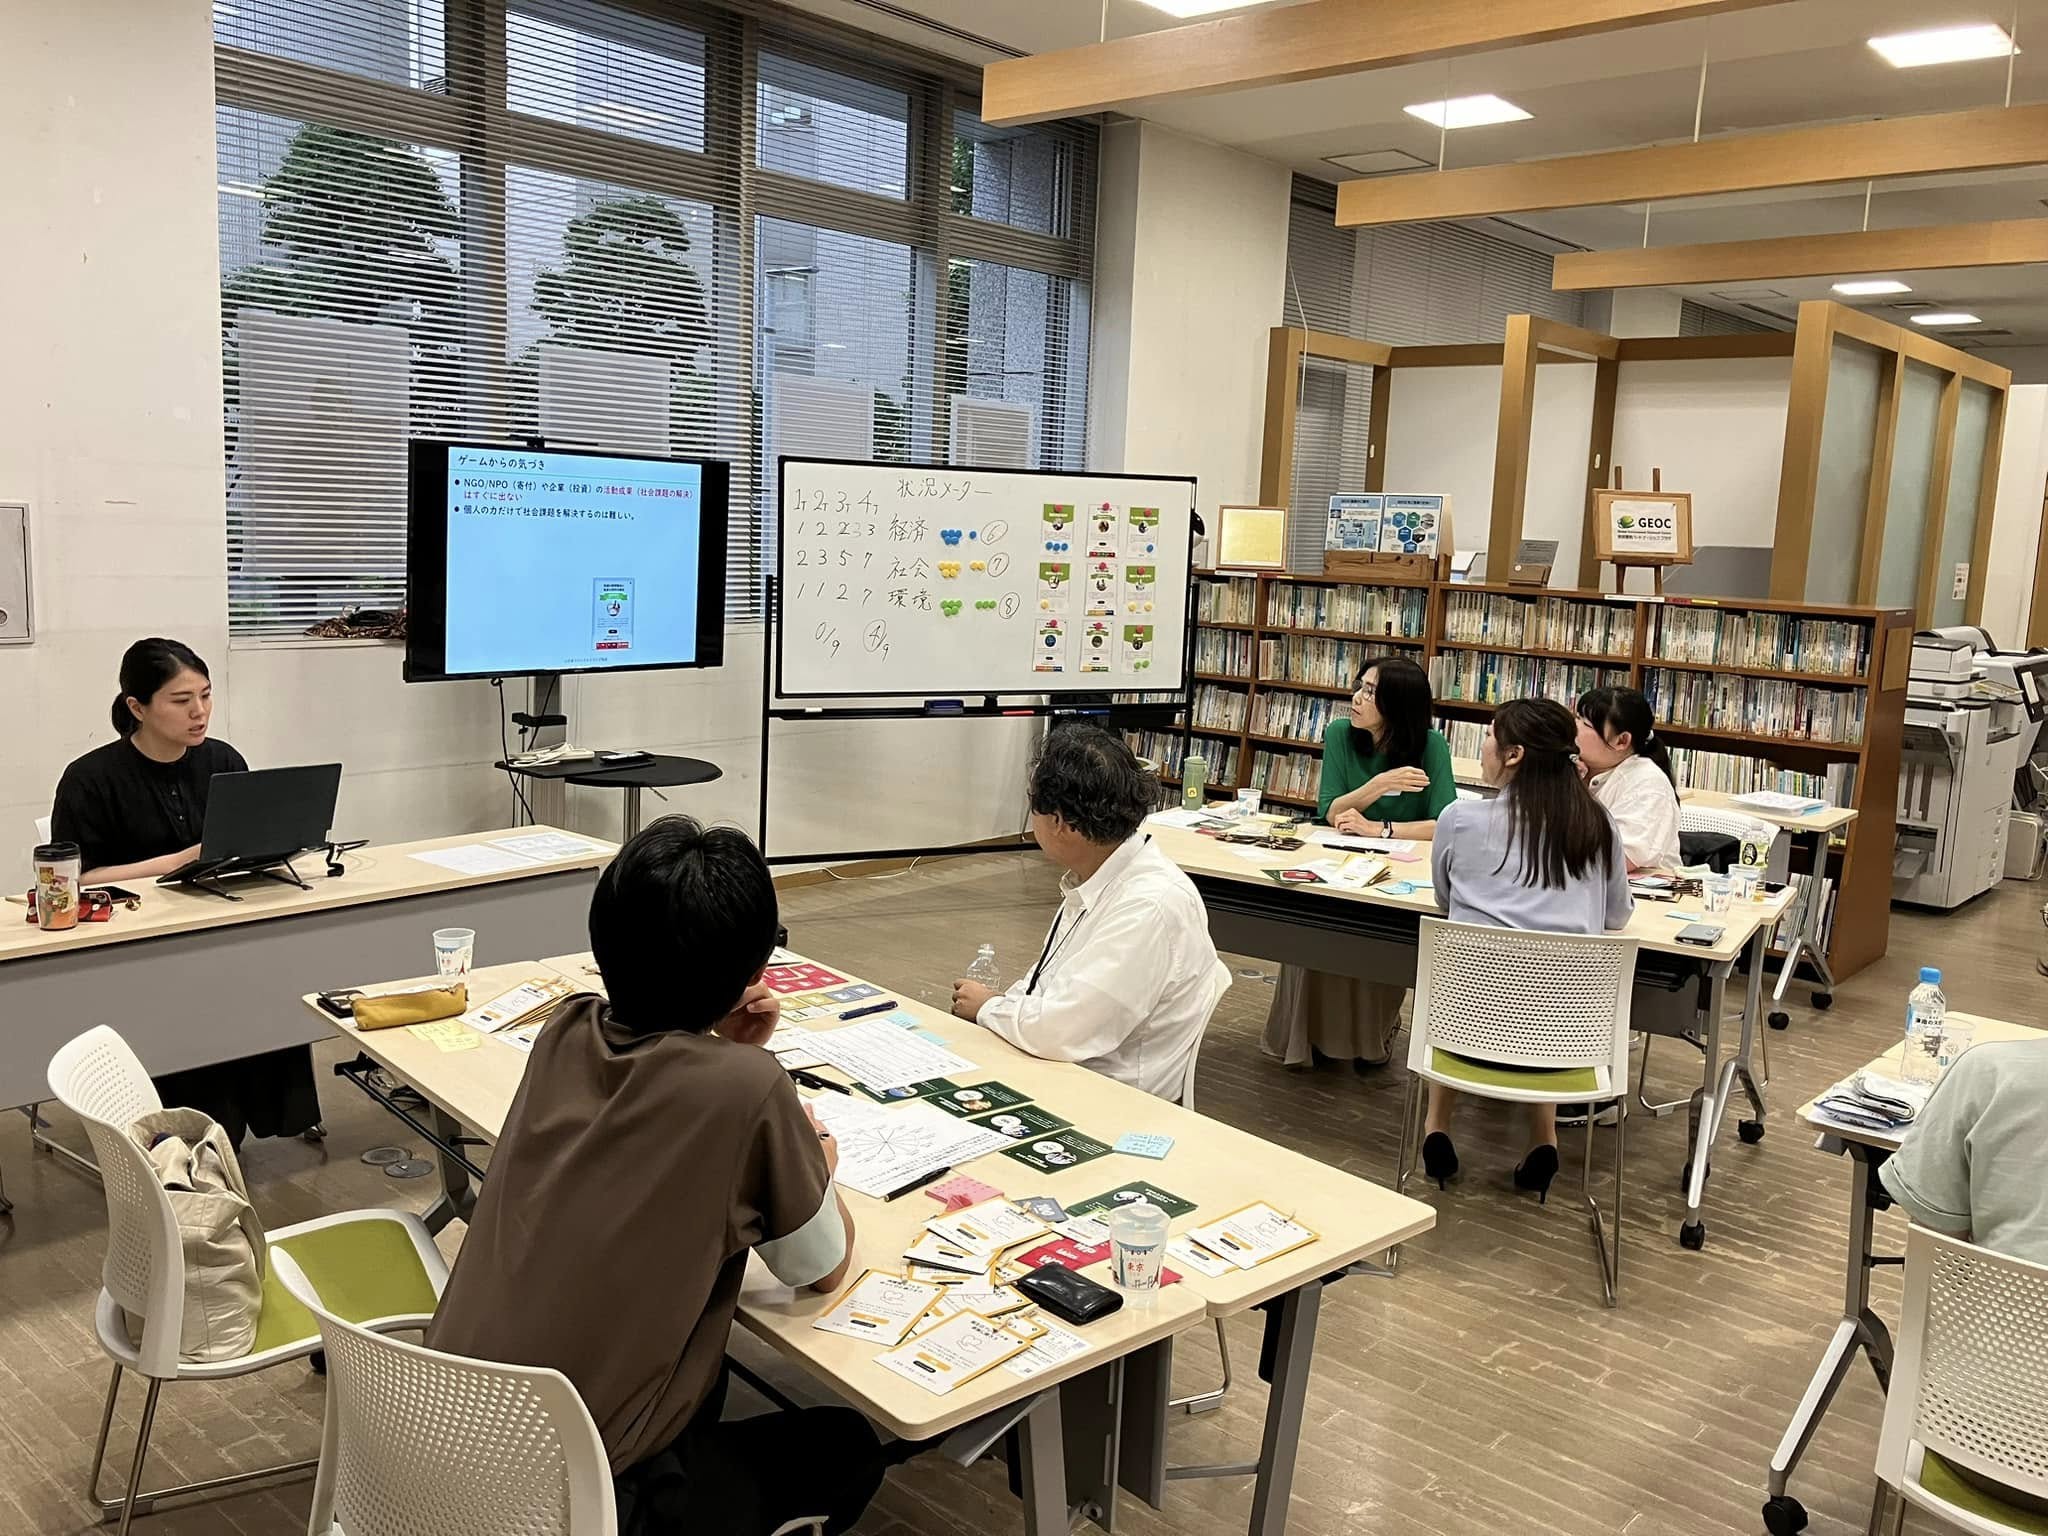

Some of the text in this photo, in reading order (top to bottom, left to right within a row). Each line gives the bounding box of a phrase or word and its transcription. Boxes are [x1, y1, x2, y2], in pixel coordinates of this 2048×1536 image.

[458, 454, 545, 471] ゲームからの気づき
[463, 490, 523, 502] はすぐに出ない
[897, 477, 992, 501] 状況メーター
[816, 521, 828, 536] 2
[867, 523, 876, 536] 3
[888, 513, 928, 543] 経済
[1638, 517, 1671, 529] GEOC
[797, 549, 809, 566] 2
[818, 548, 828, 566] 3
[839, 549, 853, 567] 5
[886, 556, 930, 580] 社会
[836, 584, 849, 600] 2
[862, 588, 873, 608] 7
